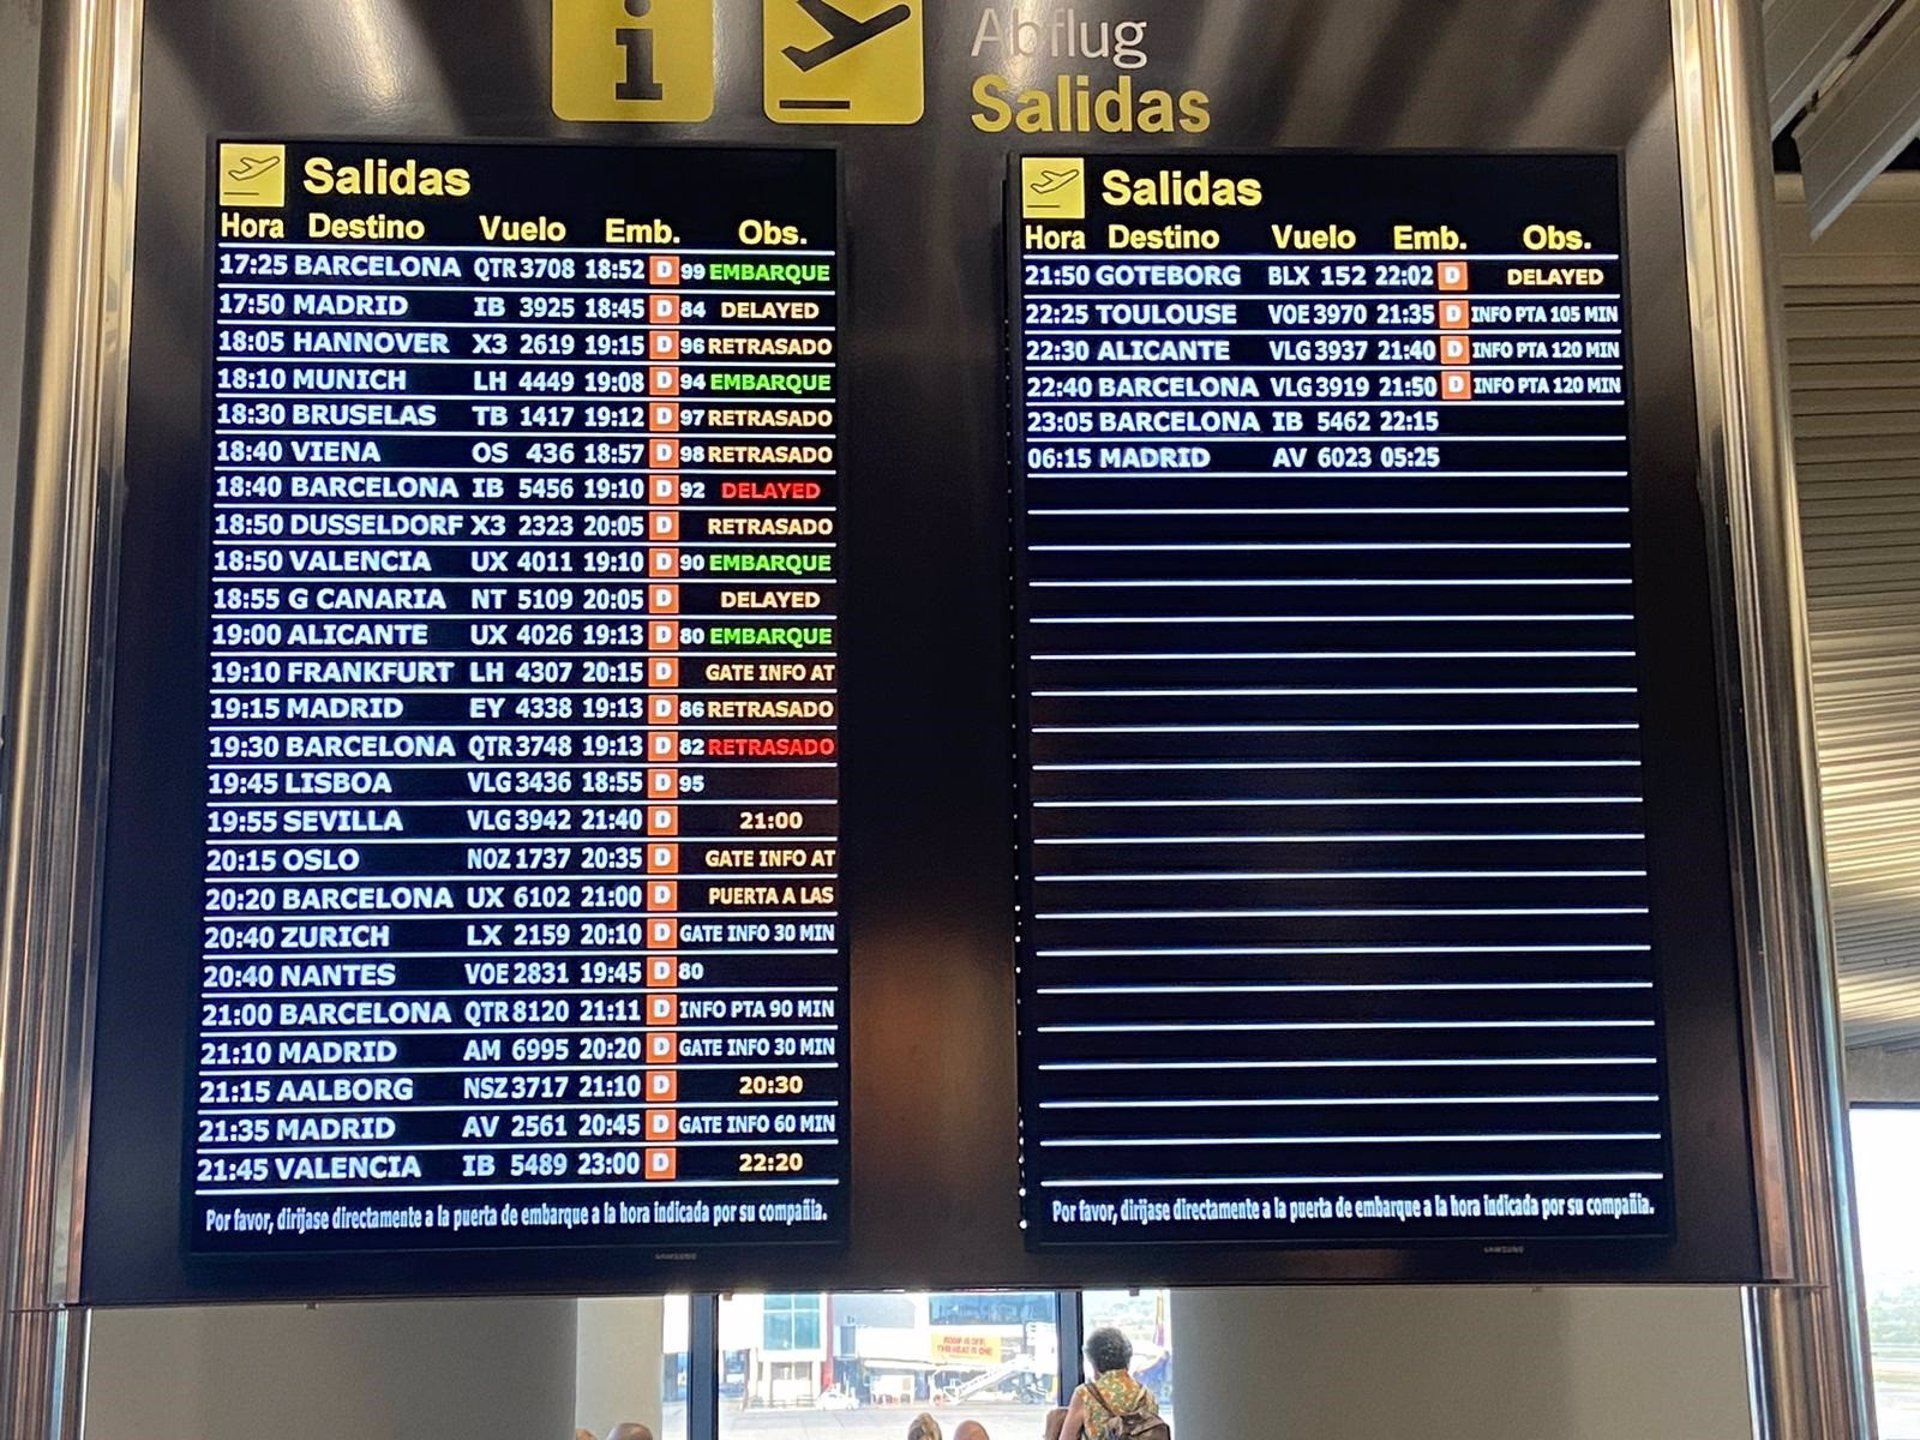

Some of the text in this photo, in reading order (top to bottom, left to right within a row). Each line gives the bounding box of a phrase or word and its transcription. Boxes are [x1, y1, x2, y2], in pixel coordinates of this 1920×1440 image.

[971, 7, 1147, 69] Abflug
[971, 73, 1210, 133] Salidas
[303, 156, 471, 197] Salidas
[1101, 169, 1263, 207] Salidas
[221, 211, 808, 246] Hora Destino Vuelo Emb. Obs.
[1025, 223, 1592, 251] Hora Destino Vuelo Emb. Obs.
[1025, 264, 1605, 287] 21:50 GOTEBORG BLX 152 22:02 D DELAYED
[219, 292, 820, 319] 17:50 MADRID IB 3925 18:45 D 84 DELAYED
[217, 367, 831, 395] 18:10 MUNICH LH 4449 19:08 D 94 EMBARQUE
[1027, 410, 1440, 433] 23:05 BARCELONA IB 5462 22:15
[1027, 445, 1441, 470] 06:15 MADRID AV 6023 05:25
[215, 475, 822, 500] 18:40 BARCELONA IB 5456 19:10 D 92 DELAYED
[213, 587, 821, 611] 18:55 G CANARIA NT 5109 20:05 D DELAYED
[211, 660, 836, 684] 19:10 FRANKFURT LH 4307 20:15 D GATE INFO AT
[210, 696, 834, 720] 19:15 MADRID EY 4338 19:13 D 86 RETRASADO
[204, 884, 834, 912] 20:20 BARCELONA UX 6102 21:00 D PUERTA A LAS
[203, 922, 835, 950] 20:40 ZURICH LX 2159 20:10 D GATE INFO 30 MIN
[200, 1036, 836, 1066] 21:10 MADRID AM 6995 20:20 D GATE INFO 30 MIN
[196, 1151, 803, 1182] 21:45 VALENCIA IB 5489 23:00 D 22:20
[205, 1208, 233, 1232] Por
[232, 1207, 275, 1236] favor,
[331, 1205, 423, 1230] directamente
[424, 1208, 435, 1228] a
[436, 1203, 451, 1228] la
[452, 1204, 499, 1232] puerta
[500, 1202, 519, 1227] de
[520, 1202, 590, 1230] embarque
[590, 1205, 601, 1225] a
[603, 1201, 617, 1225] la
[619, 1200, 651, 1225] hora
[653, 1199, 711, 1224] indicada
[712, 1203, 738, 1227] por
[738, 1203, 756, 1223] su
[1051, 1199, 1078, 1223] Por
[1077, 1198, 1119, 1226] favor,
[1172, 1197, 1261, 1221] directamente
[1261, 1200, 1272, 1220] a
[1273, 1196, 1288, 1220] la
[1289, 1196, 1334, 1224] puerta
[1334, 1195, 1354, 1219] de
[1354, 1195, 1422, 1222] embarque
[1422, 1198, 1433, 1218] a
[1434, 1194, 1449, 1218] la
[1449, 1194, 1482, 1218] hora
[1482, 1193, 1540, 1217] indicada
[1540, 1197, 1566, 1221] por
[1566, 1197, 1585, 1217] su
